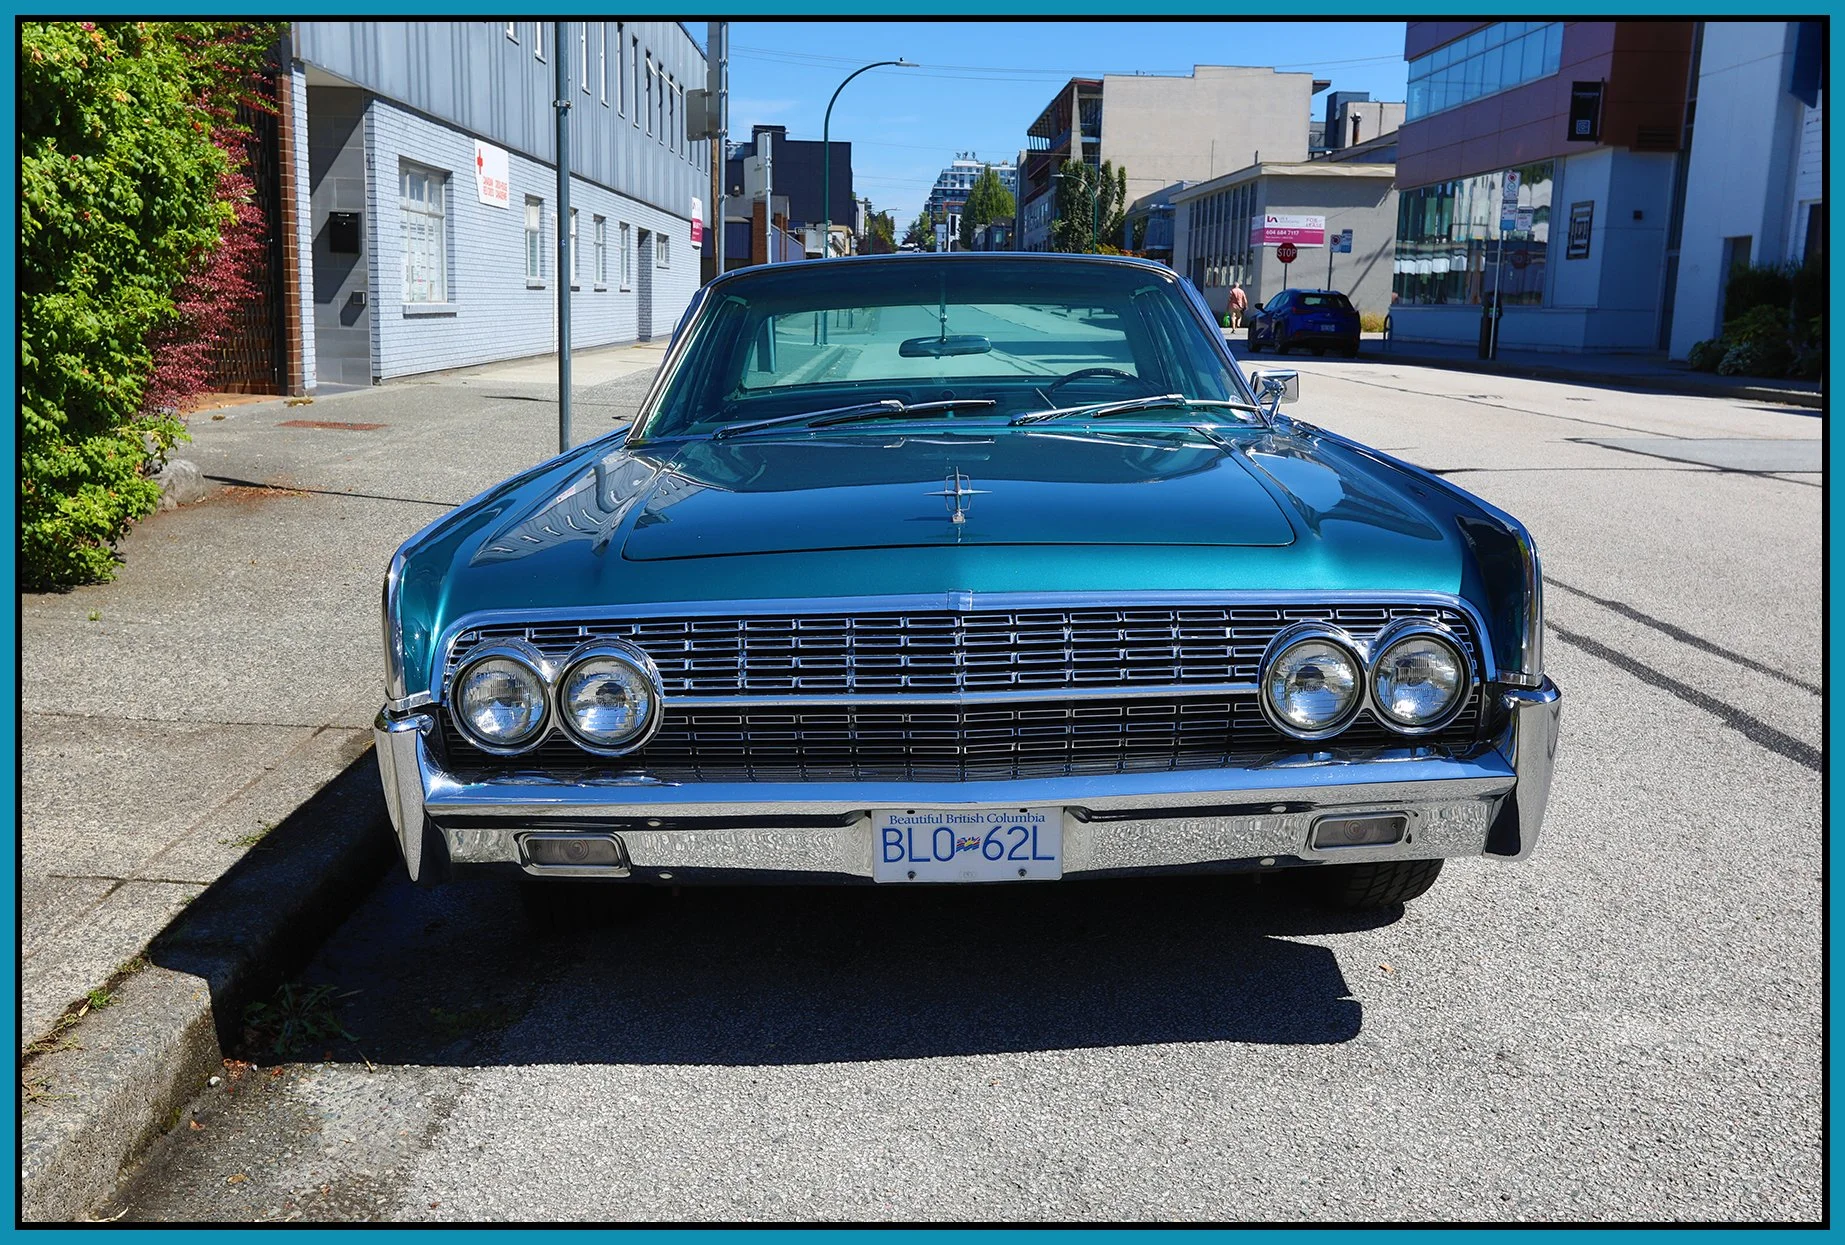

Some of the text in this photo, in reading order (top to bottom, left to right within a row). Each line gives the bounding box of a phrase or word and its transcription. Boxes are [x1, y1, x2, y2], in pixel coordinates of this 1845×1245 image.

[1277, 248, 1297, 257] STOP
[889, 812, 1046, 825] Beautiful British Columbia
[981, 825, 1056, 863] 62L
